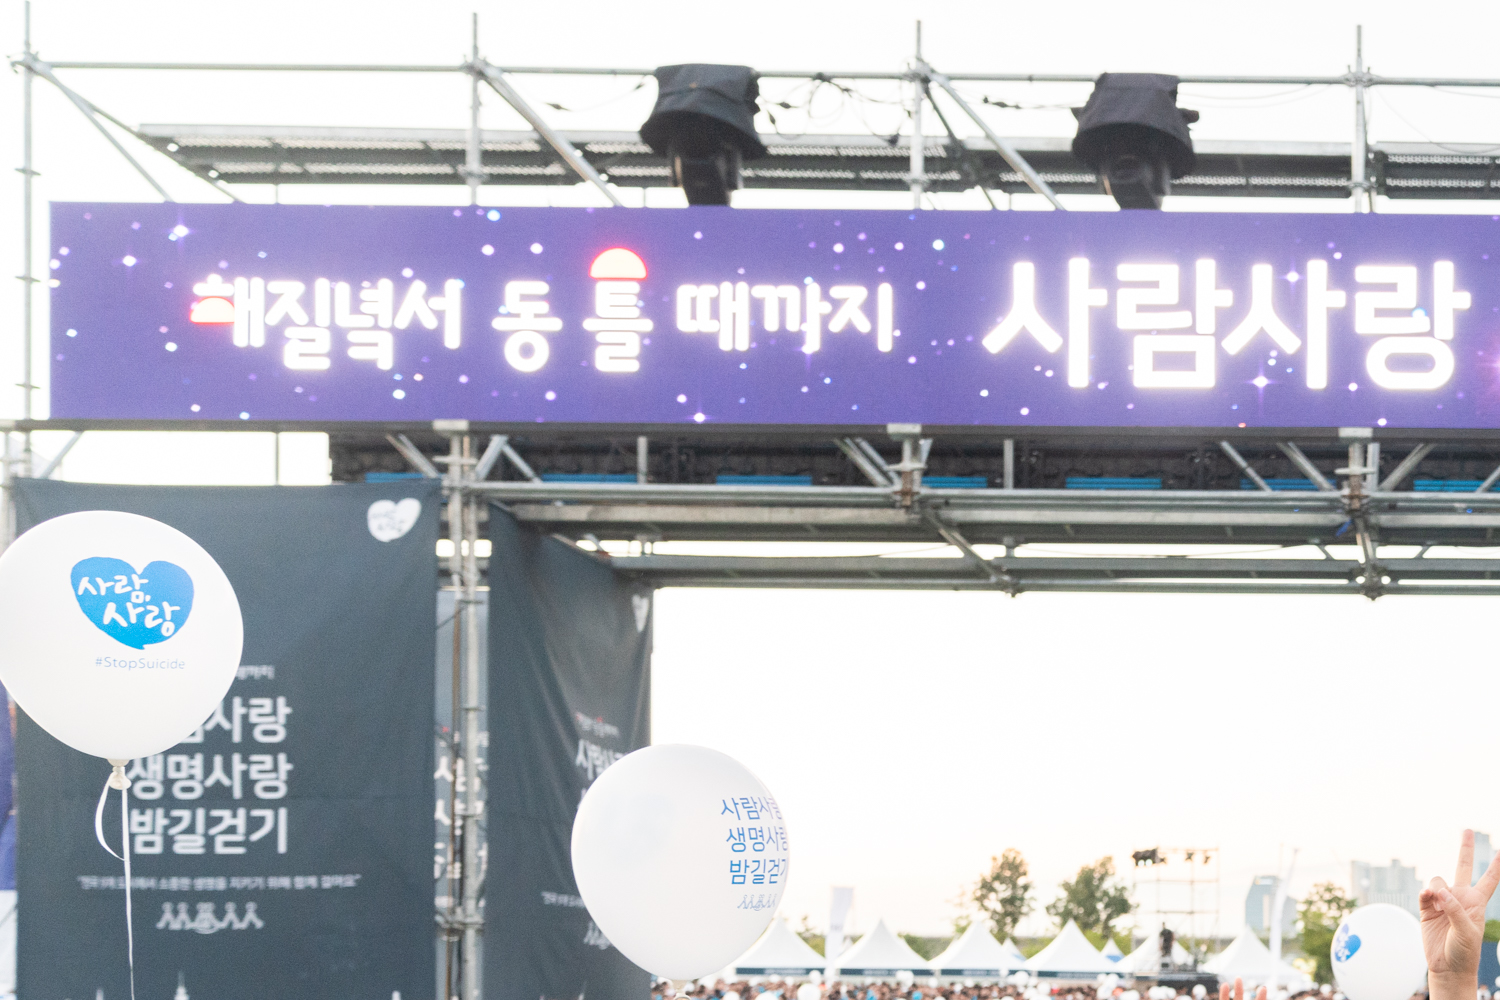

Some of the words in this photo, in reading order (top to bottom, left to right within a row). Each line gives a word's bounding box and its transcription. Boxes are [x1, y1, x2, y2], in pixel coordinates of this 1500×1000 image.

[492, 279, 563, 372] 동
[583, 278, 653, 373] 틀
[676, 281, 894, 353] 때까지
[982, 257, 1472, 390] 사람사랑
[103, 601, 181, 637] 사랑
[95, 655, 186, 672] #StopSuicide
[180, 695, 293, 743] 사랑
[126, 752, 294, 800] 생명사랑
[721, 796, 783, 821] 사람사랑
[129, 807, 288, 854] 밤길걷기
[726, 826, 789, 853] 생명사랑
[730, 858, 788, 885] 밤길걷기
